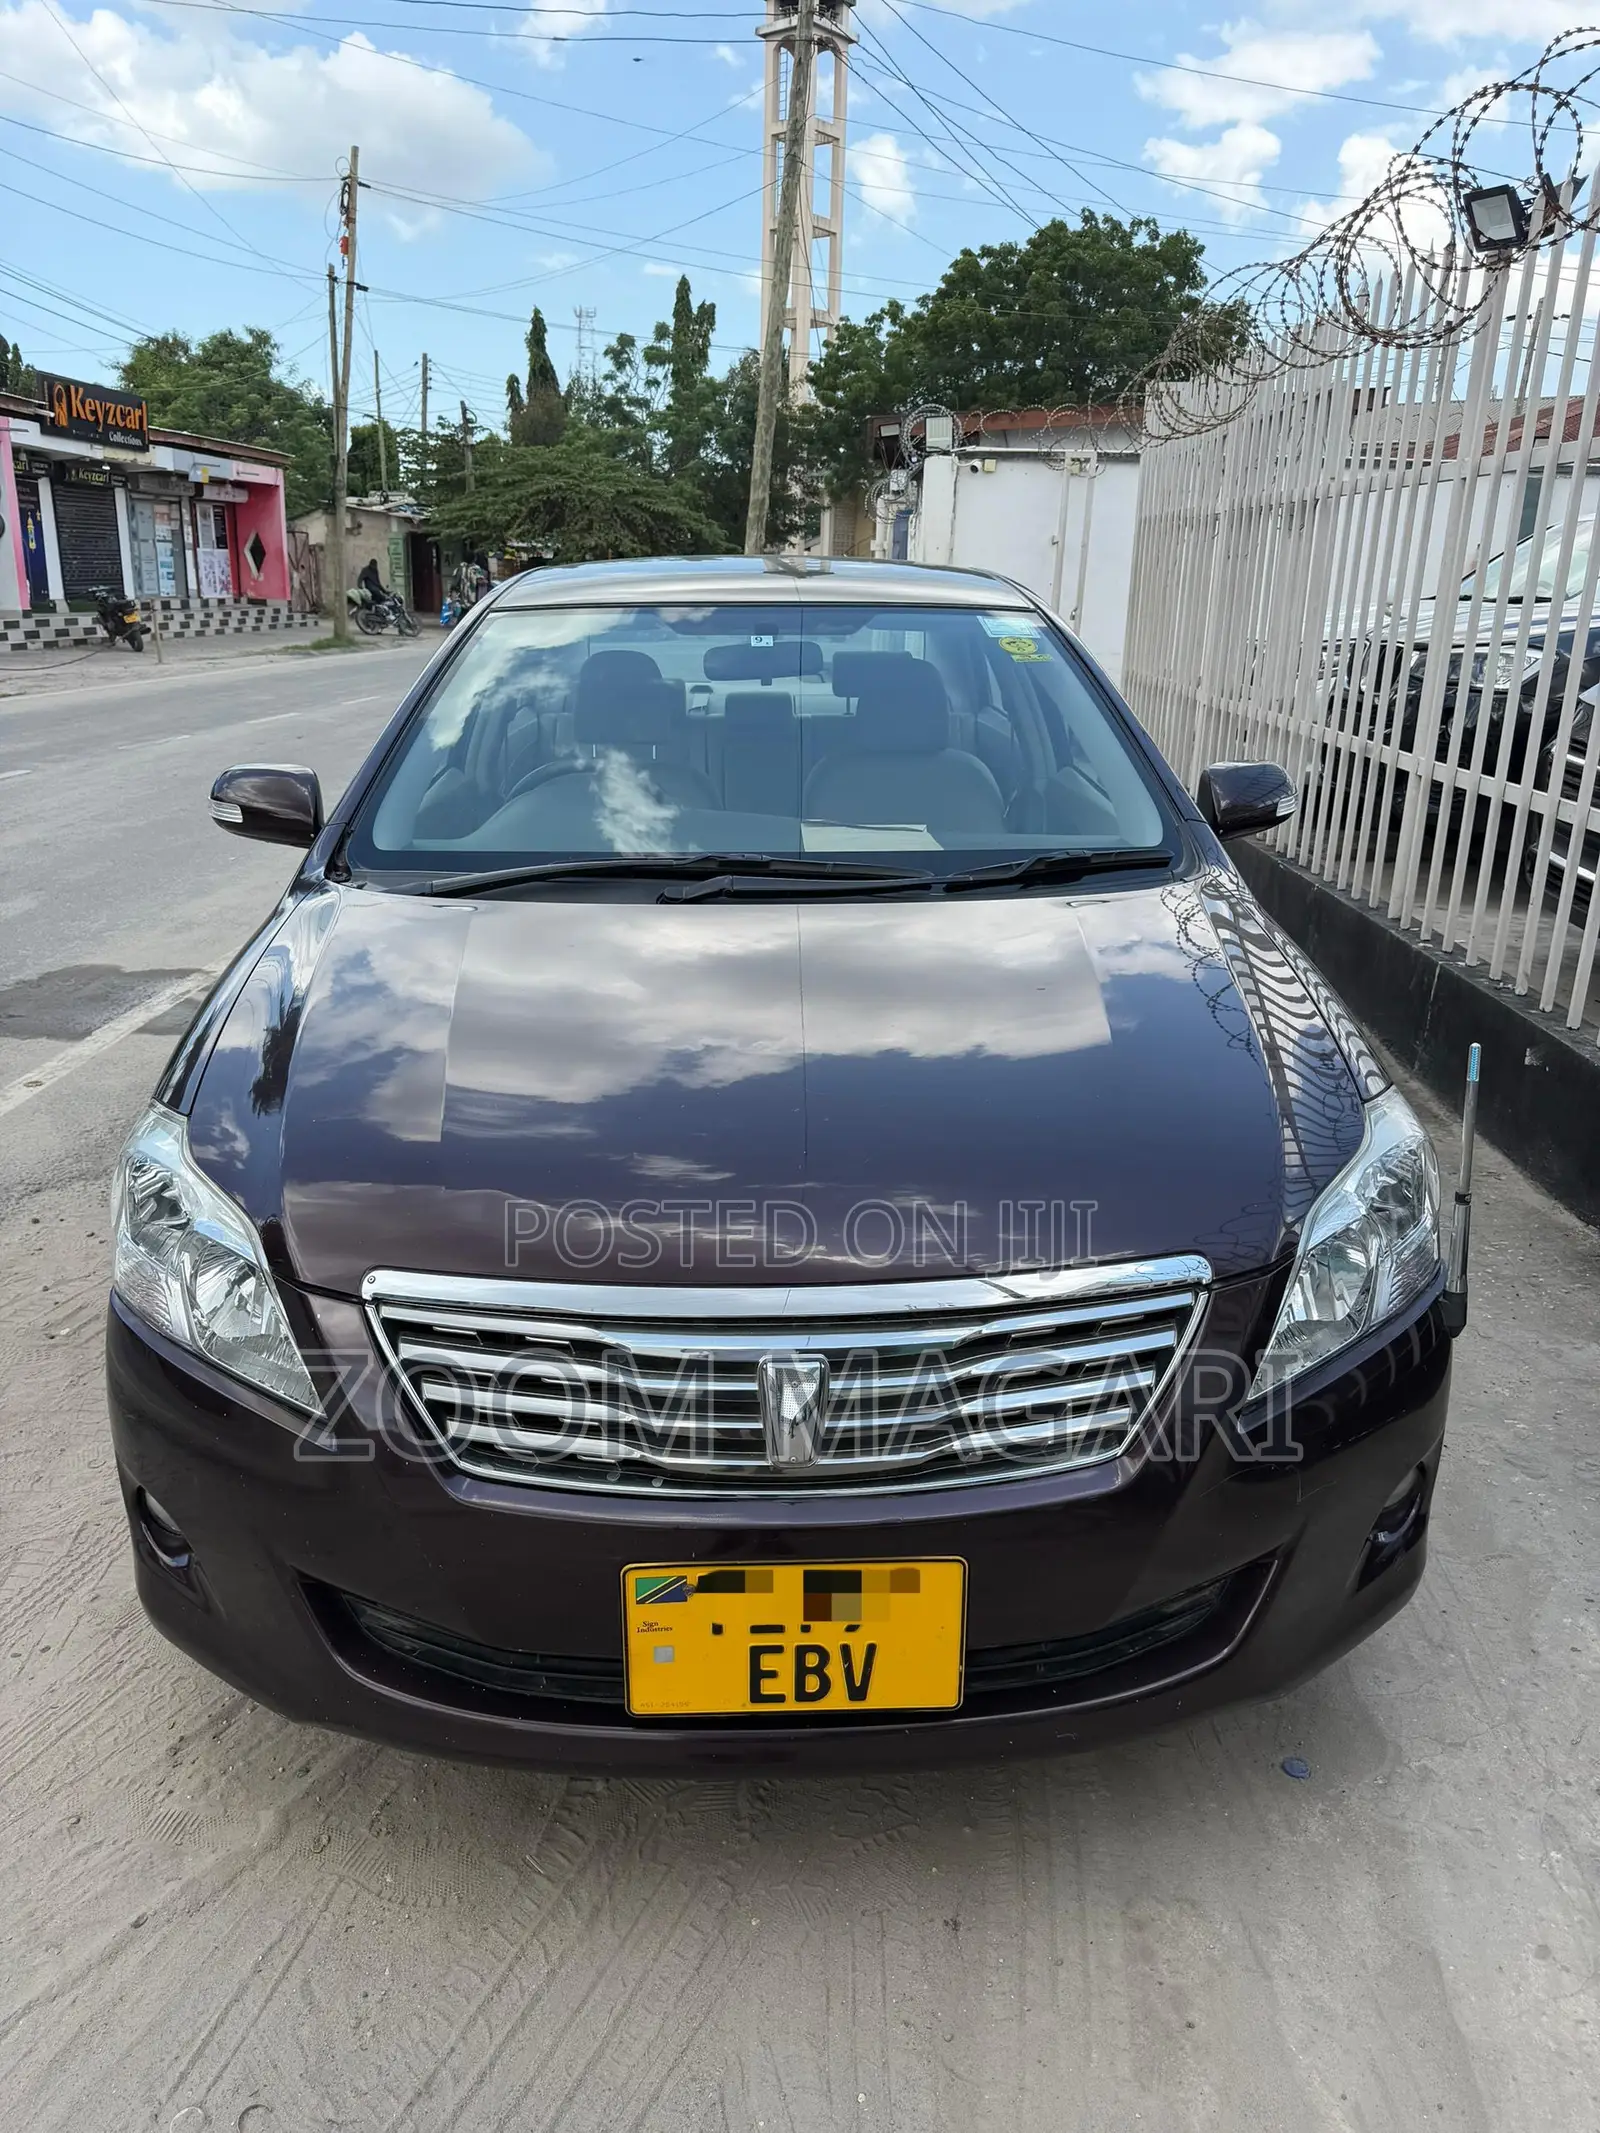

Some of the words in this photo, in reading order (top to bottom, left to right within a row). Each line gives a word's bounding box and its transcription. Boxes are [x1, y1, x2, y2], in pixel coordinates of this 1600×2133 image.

[642, 1620, 659, 1628] Sign
[636, 1626, 673, 1634] Industries
[748, 1642, 878, 1704] EBV
